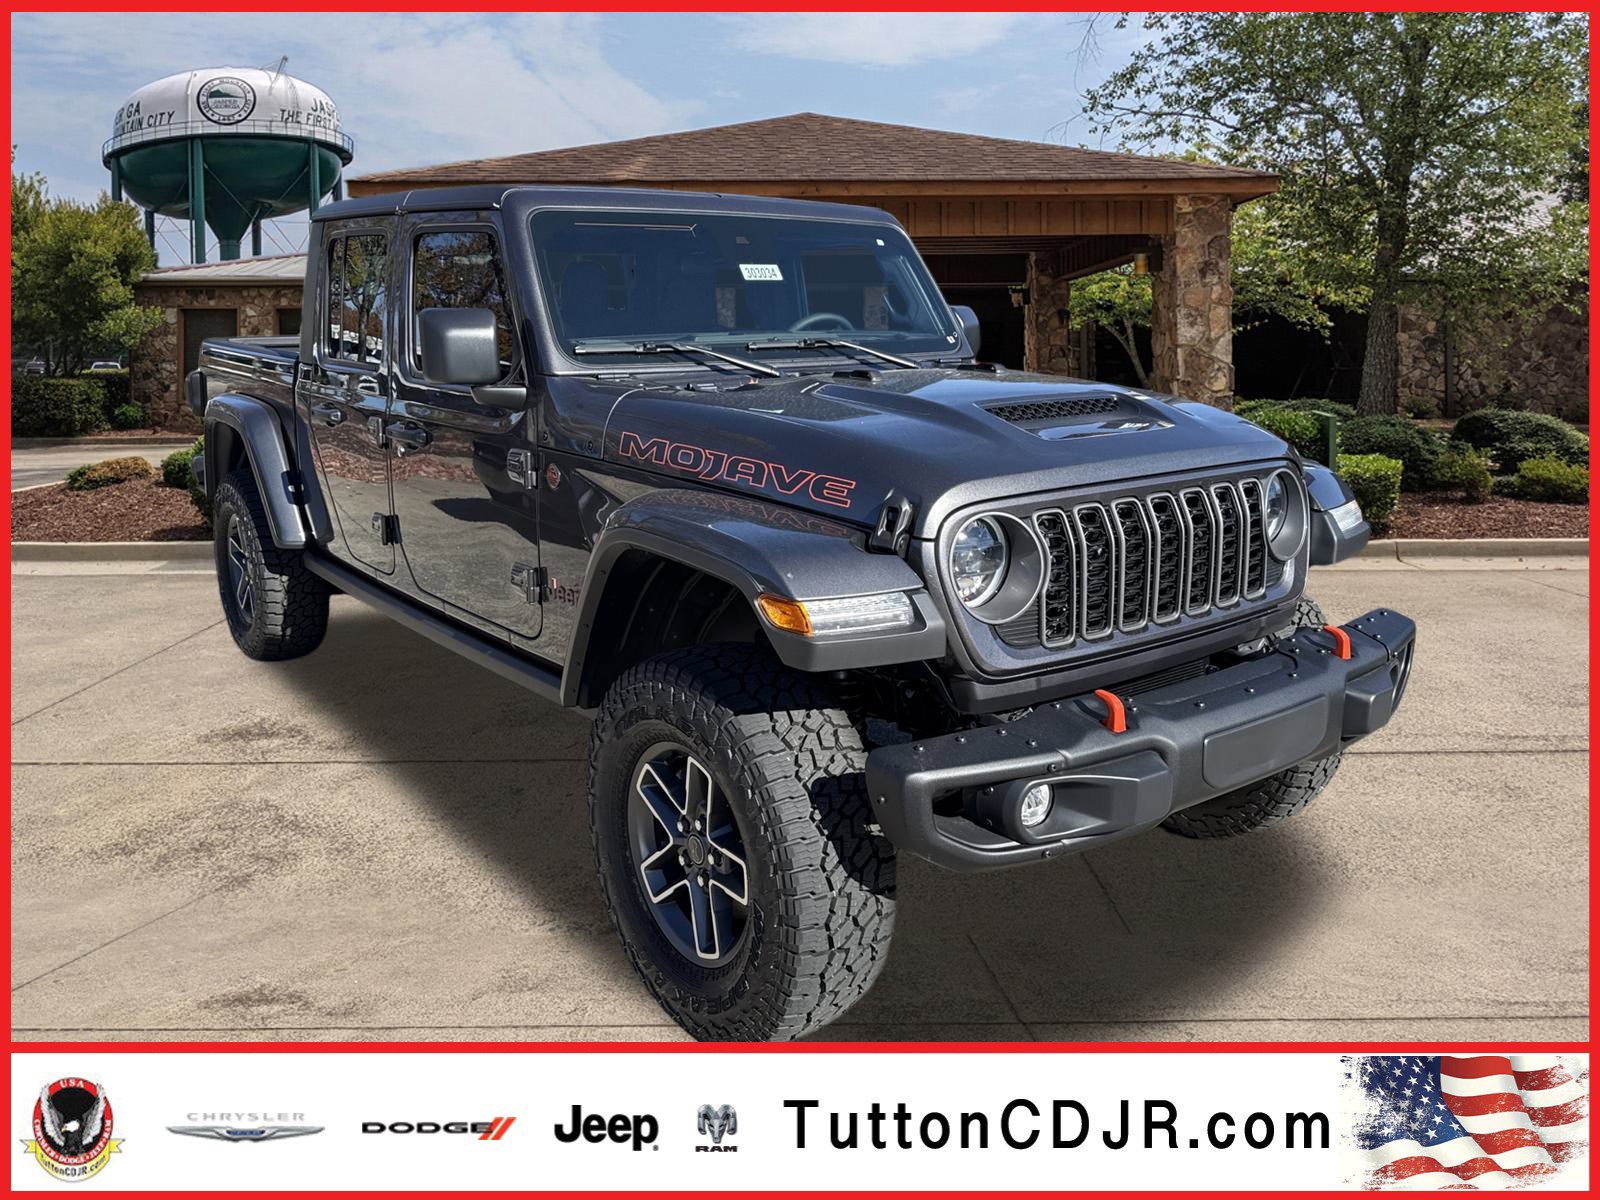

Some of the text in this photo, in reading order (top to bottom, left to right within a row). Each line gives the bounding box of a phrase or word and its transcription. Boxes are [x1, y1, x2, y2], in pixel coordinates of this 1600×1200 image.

[126, 101, 141, 118] GA
[280, 108, 303, 124] THE
[147, 110, 175, 128] CITY
[744, 267, 778, 279] 303034
[619, 431, 856, 508] MOJAVE
